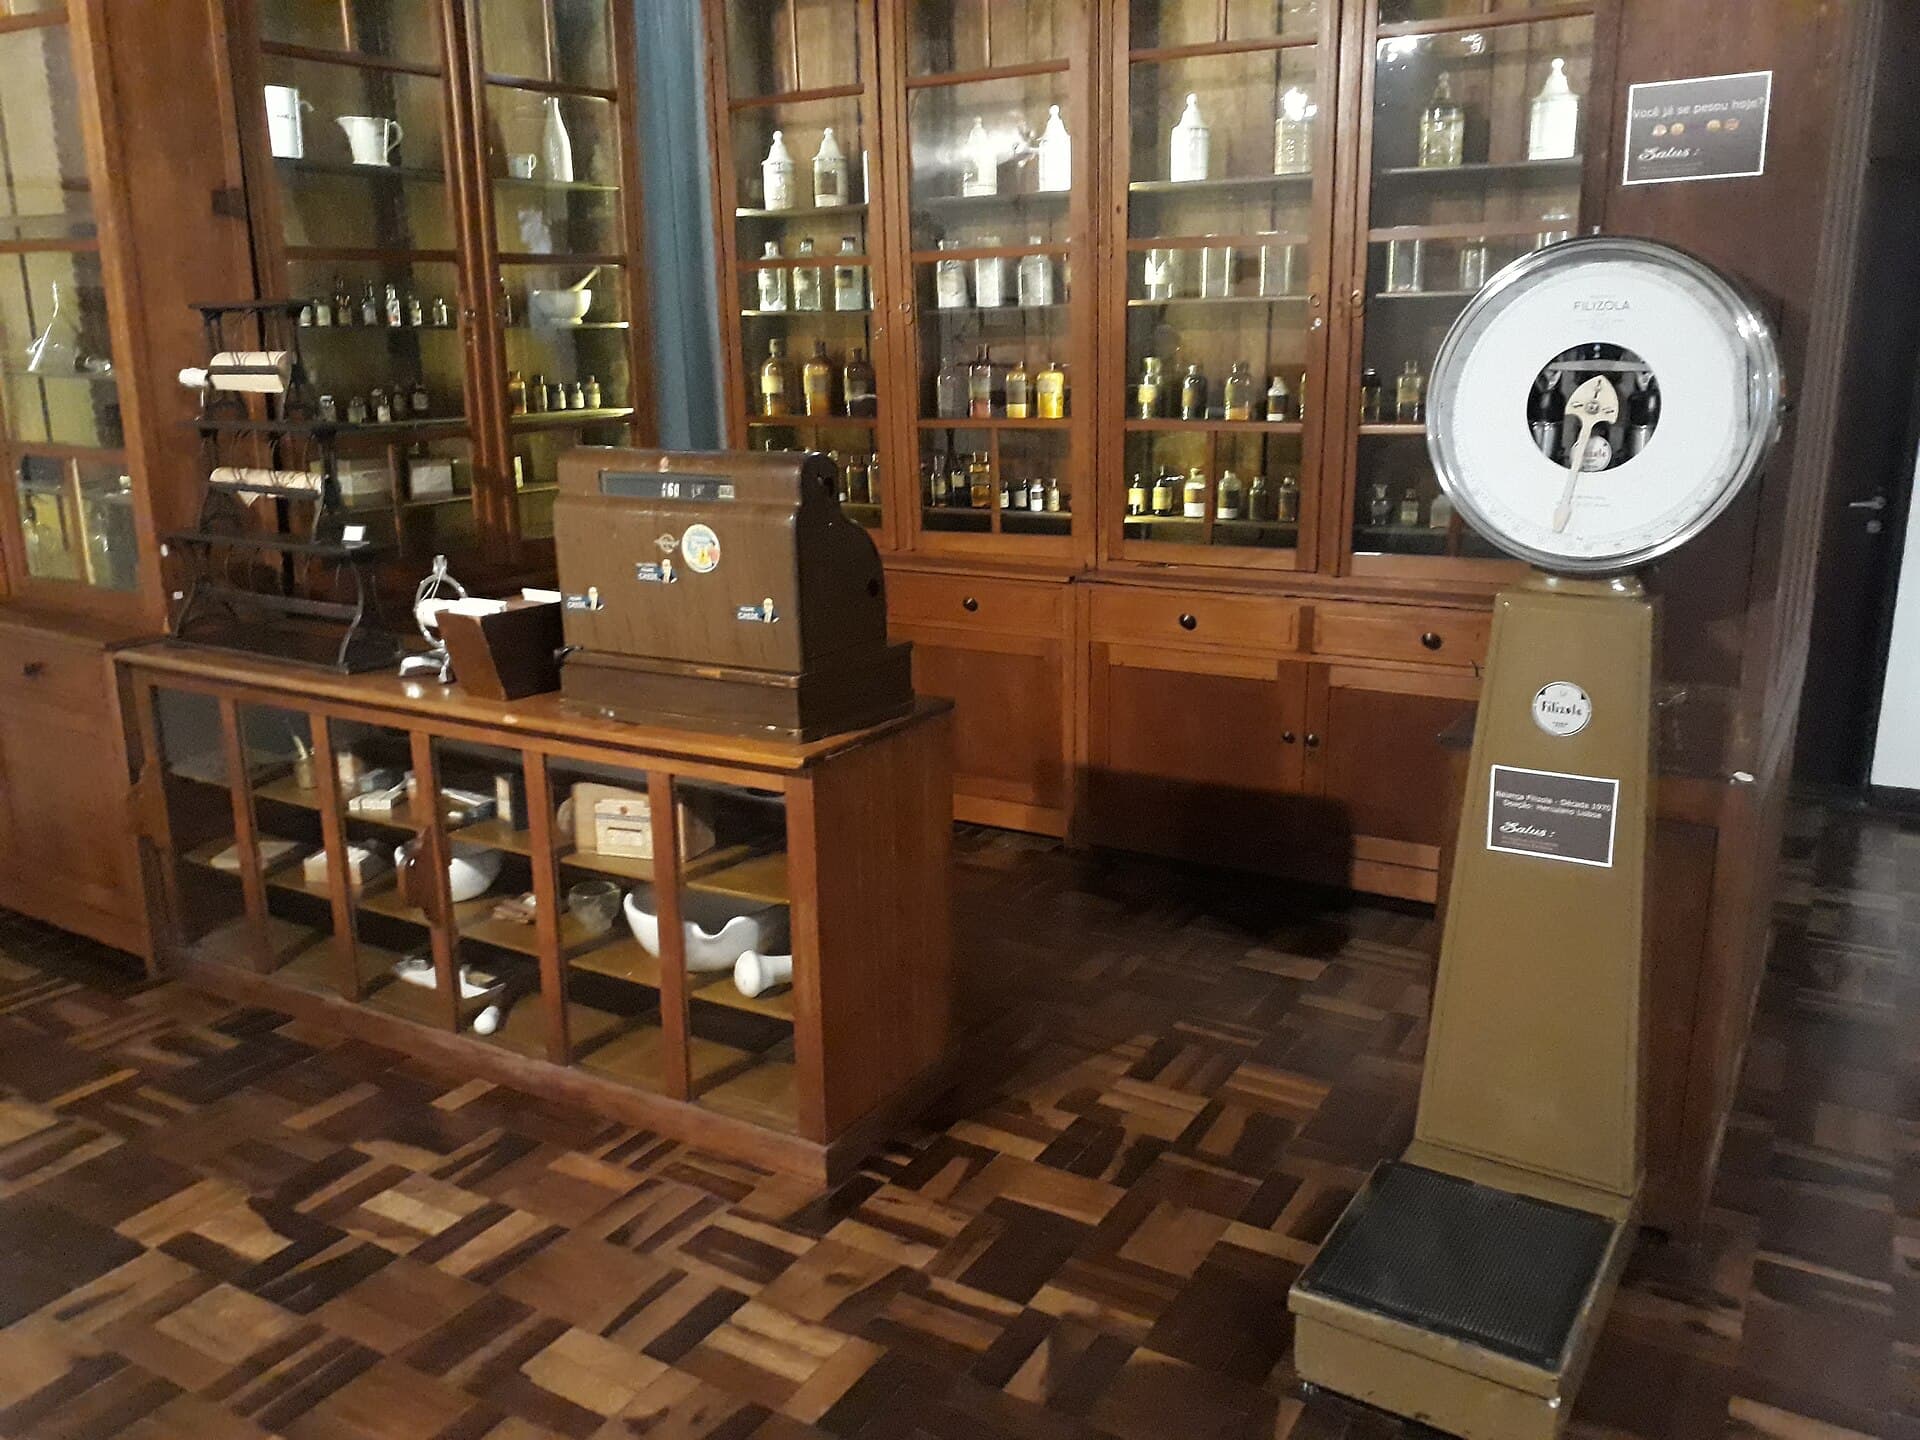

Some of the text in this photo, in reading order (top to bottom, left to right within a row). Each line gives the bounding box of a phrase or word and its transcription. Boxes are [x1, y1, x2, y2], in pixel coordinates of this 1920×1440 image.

[1677, 104, 1691, 115] se
[1693, 101, 1729, 115] pesou
[1732, 96, 1765, 111] hoje?
[1574, 300, 1630, 311] FILIZOLA
